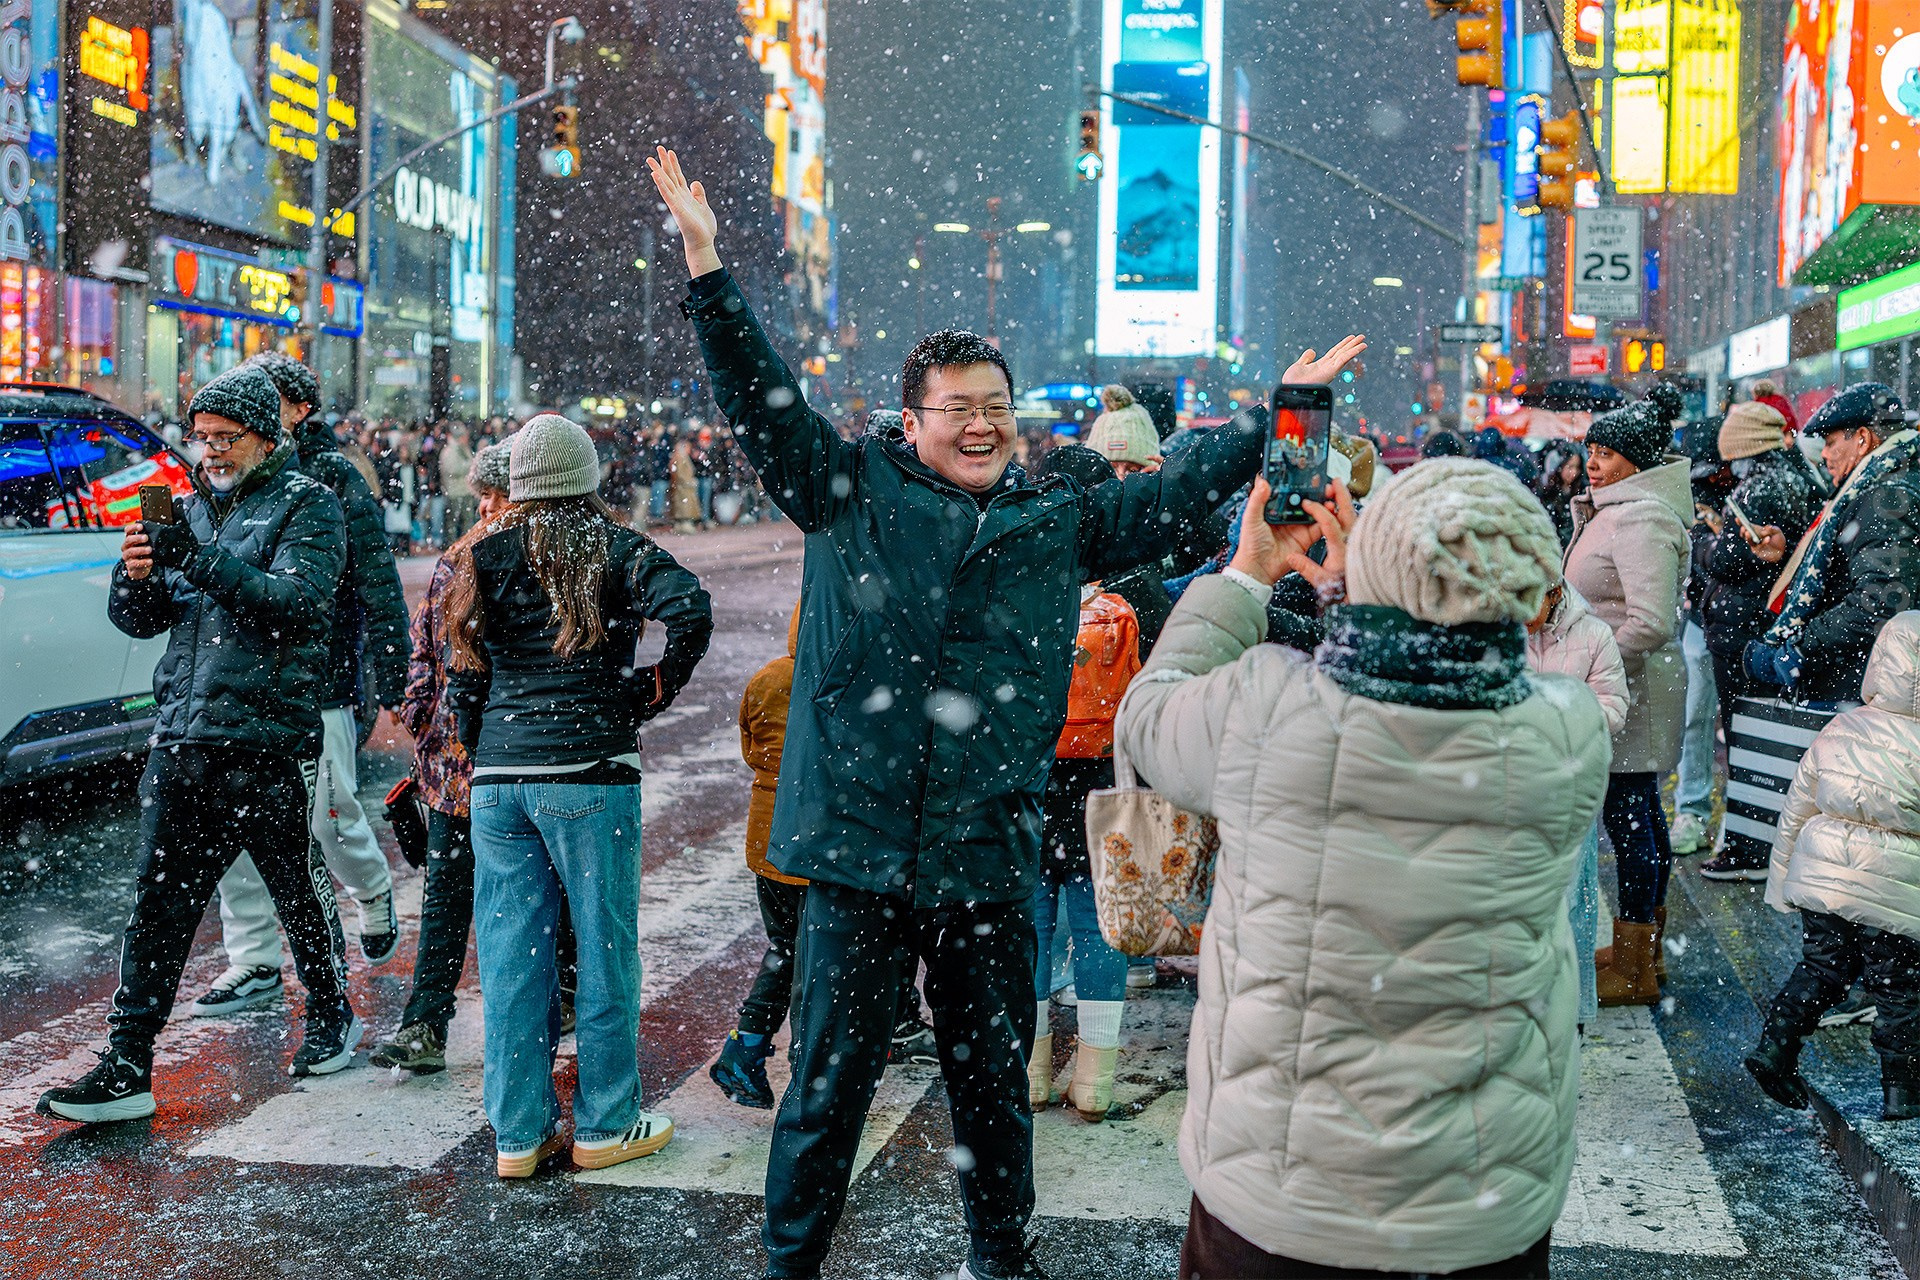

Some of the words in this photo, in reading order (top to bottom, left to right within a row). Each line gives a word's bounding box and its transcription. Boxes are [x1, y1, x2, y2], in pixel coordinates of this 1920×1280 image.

[394, 166, 435, 232] OLD
[1588, 225, 1627, 235] SPEED
[1590, 238, 1621, 247] LIMIT
[1583, 252, 1632, 281] 25
[1751, 773, 1775, 787] SEPHORA
[312, 866, 338, 921] GUESS
